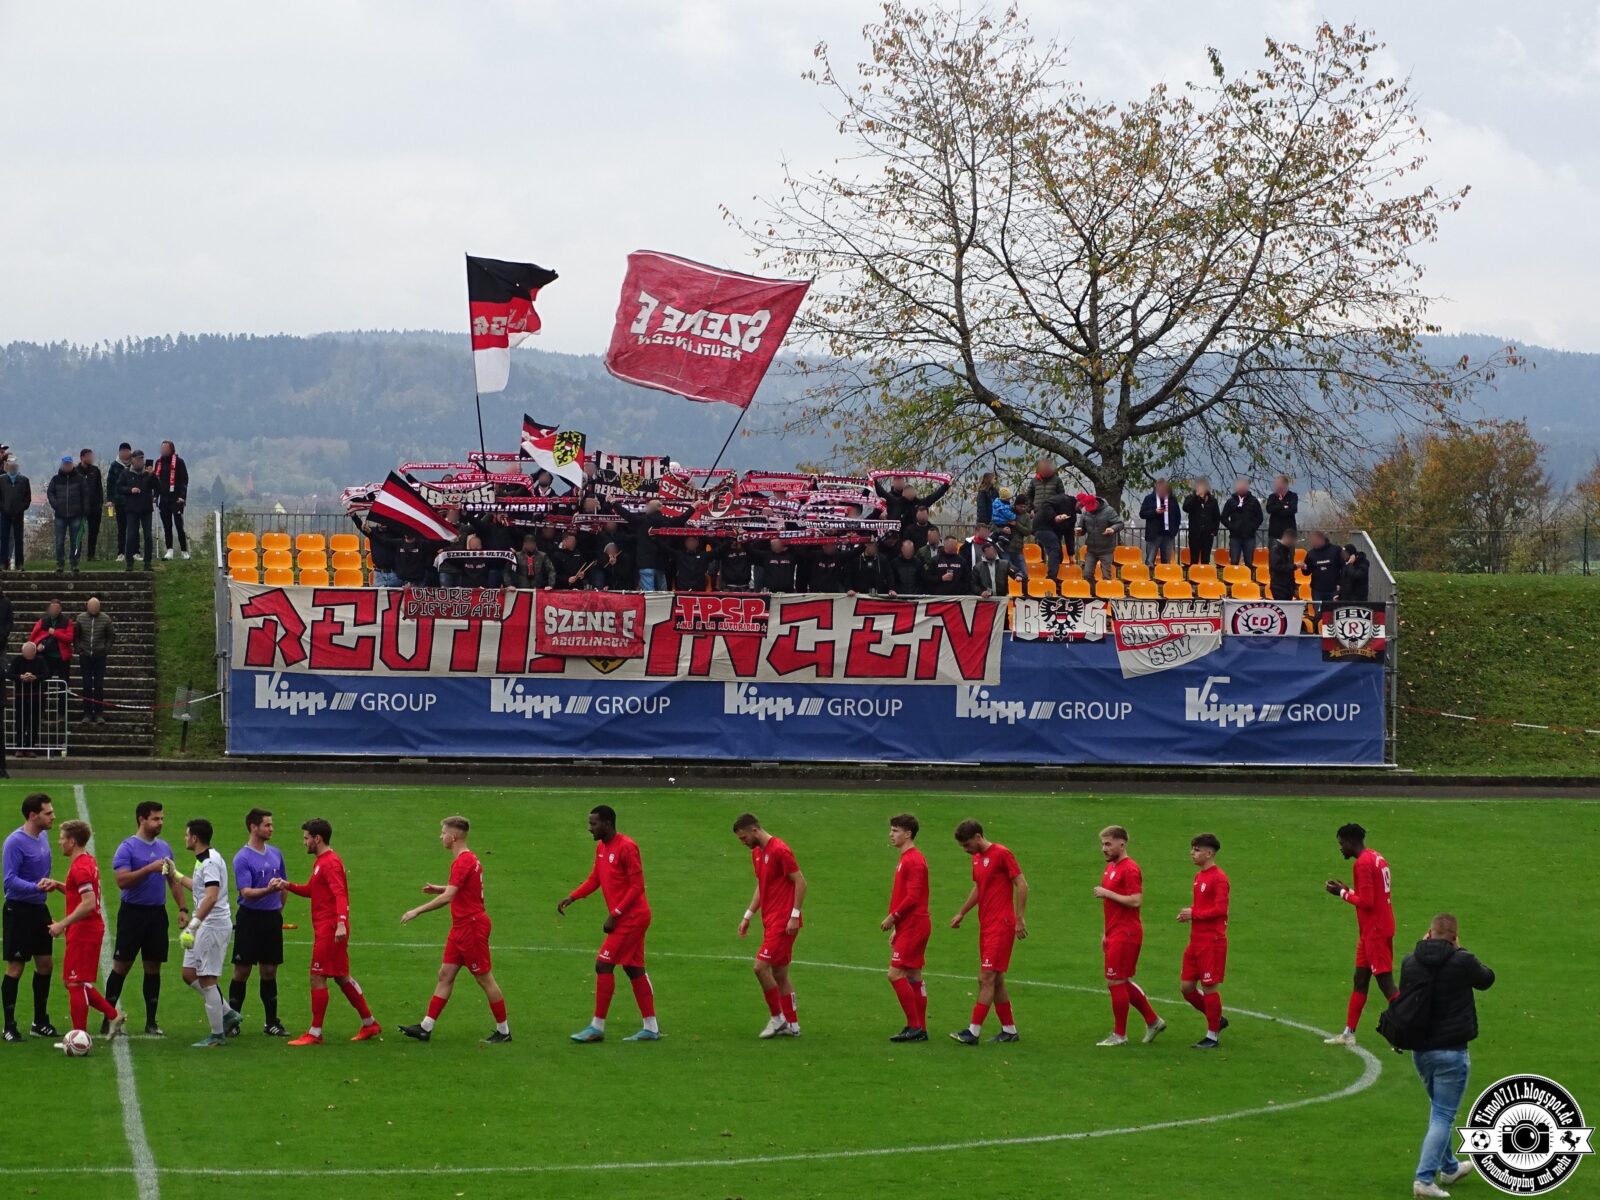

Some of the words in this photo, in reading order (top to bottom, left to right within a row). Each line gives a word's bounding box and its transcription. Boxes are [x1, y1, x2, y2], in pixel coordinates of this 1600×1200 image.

[466, 503, 546, 512] REUTLINGEN
[677, 595, 765, 625] TPSP
[1110, 600, 1160, 621] WIR
[1161, 600, 1223, 619] ALLE
[1338, 609, 1369, 619] SSV
[544, 605, 617, 635] SZENE
[622, 609, 637, 640] E
[680, 621, 694, 630] NO
[705, 622, 716, 630] LA
[718, 622, 760, 632] AUTORIDAD
[1348, 622, 1360, 635] R
[551, 636, 630, 648] REUTLINGEN
[1120, 624, 1170, 646] SIND
[1147, 635, 1192, 667] SSV
[360, 693, 437, 711] GROUP
[595, 696, 671, 714] GROUP
[827, 698, 903, 717] GROUP
[1058, 702, 1132, 720] GROUP
[1287, 703, 1361, 722] GROUP
